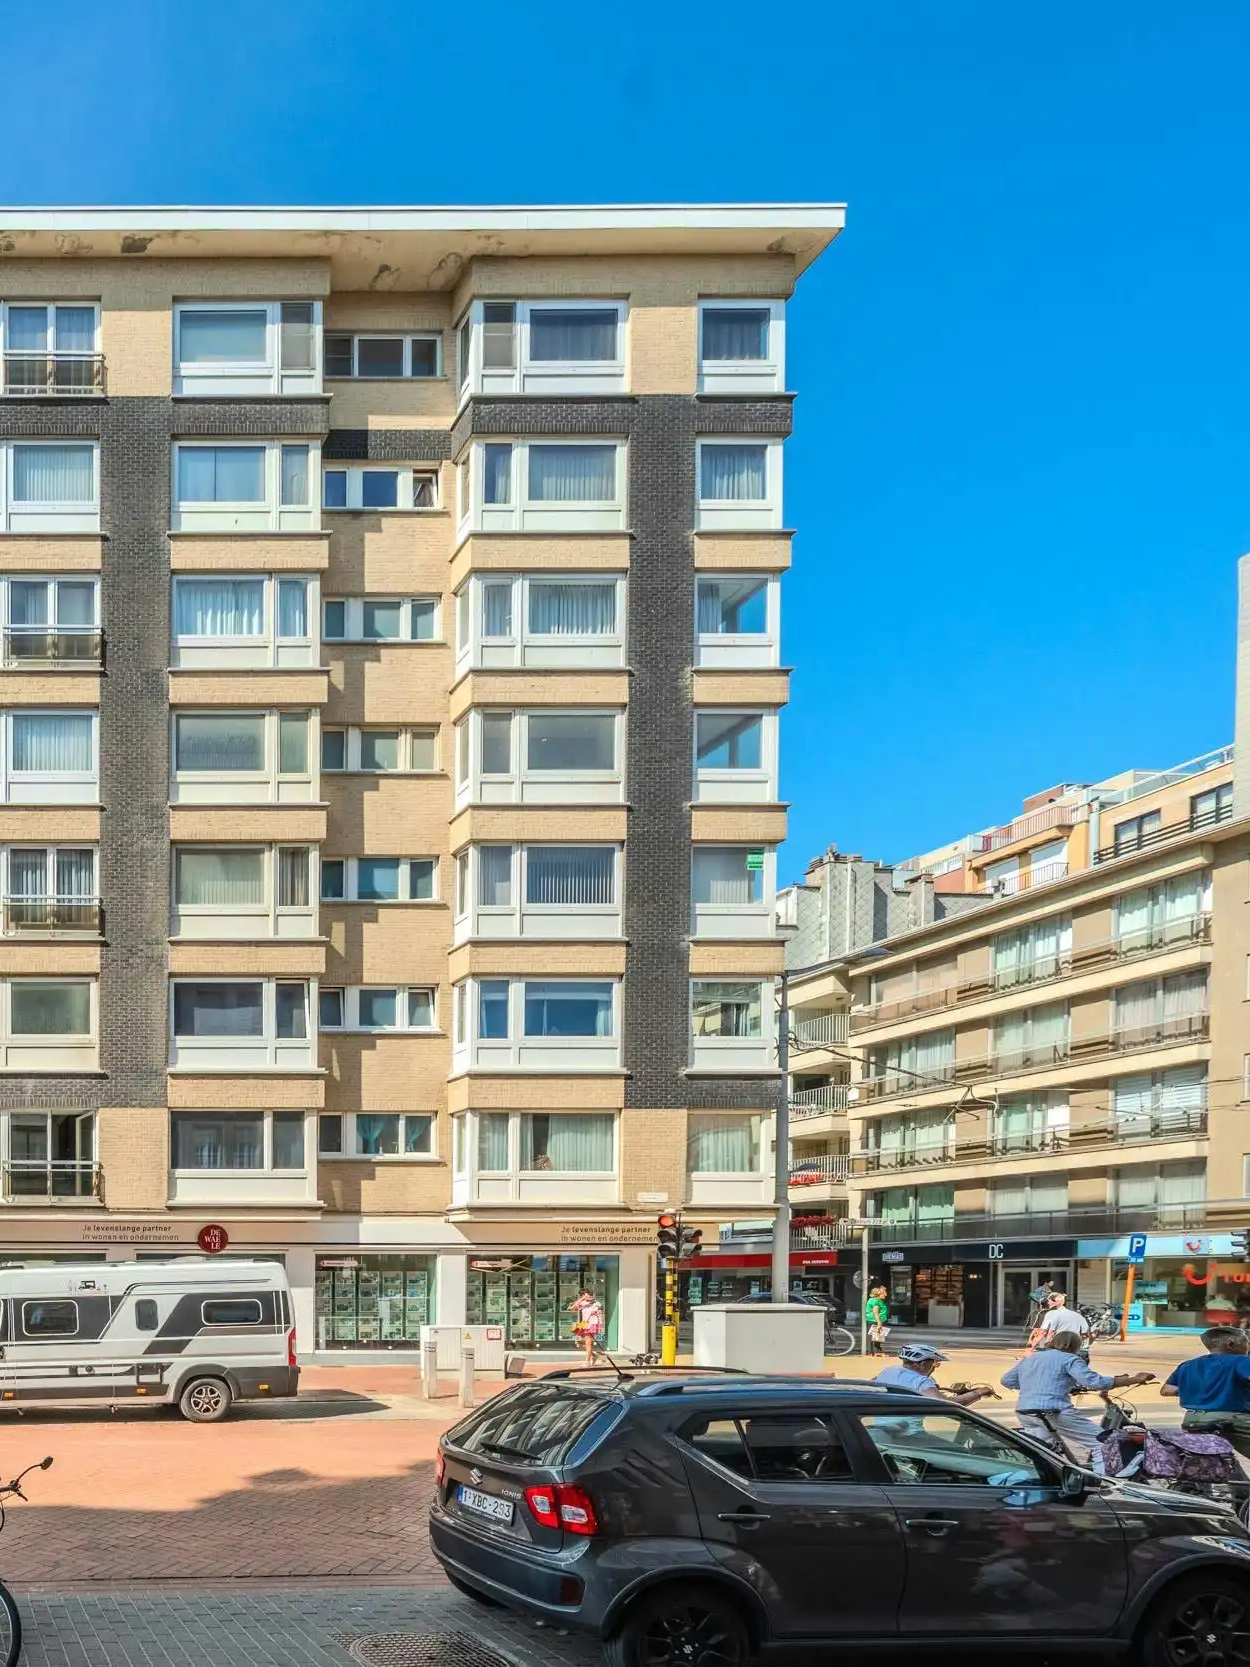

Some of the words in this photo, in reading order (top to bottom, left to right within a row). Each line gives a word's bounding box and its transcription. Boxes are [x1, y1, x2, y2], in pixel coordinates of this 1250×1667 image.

[93, 1224, 141, 1232] levenslange
[572, 1226, 619, 1234] levenslange
[621, 1226, 651, 1234] partner
[130, 1233, 179, 1241] ondernemen
[211, 1242, 221, 1250] LE
[1131, 1237, 1145, 1253] P
[989, 1243, 1004, 1259] DC
